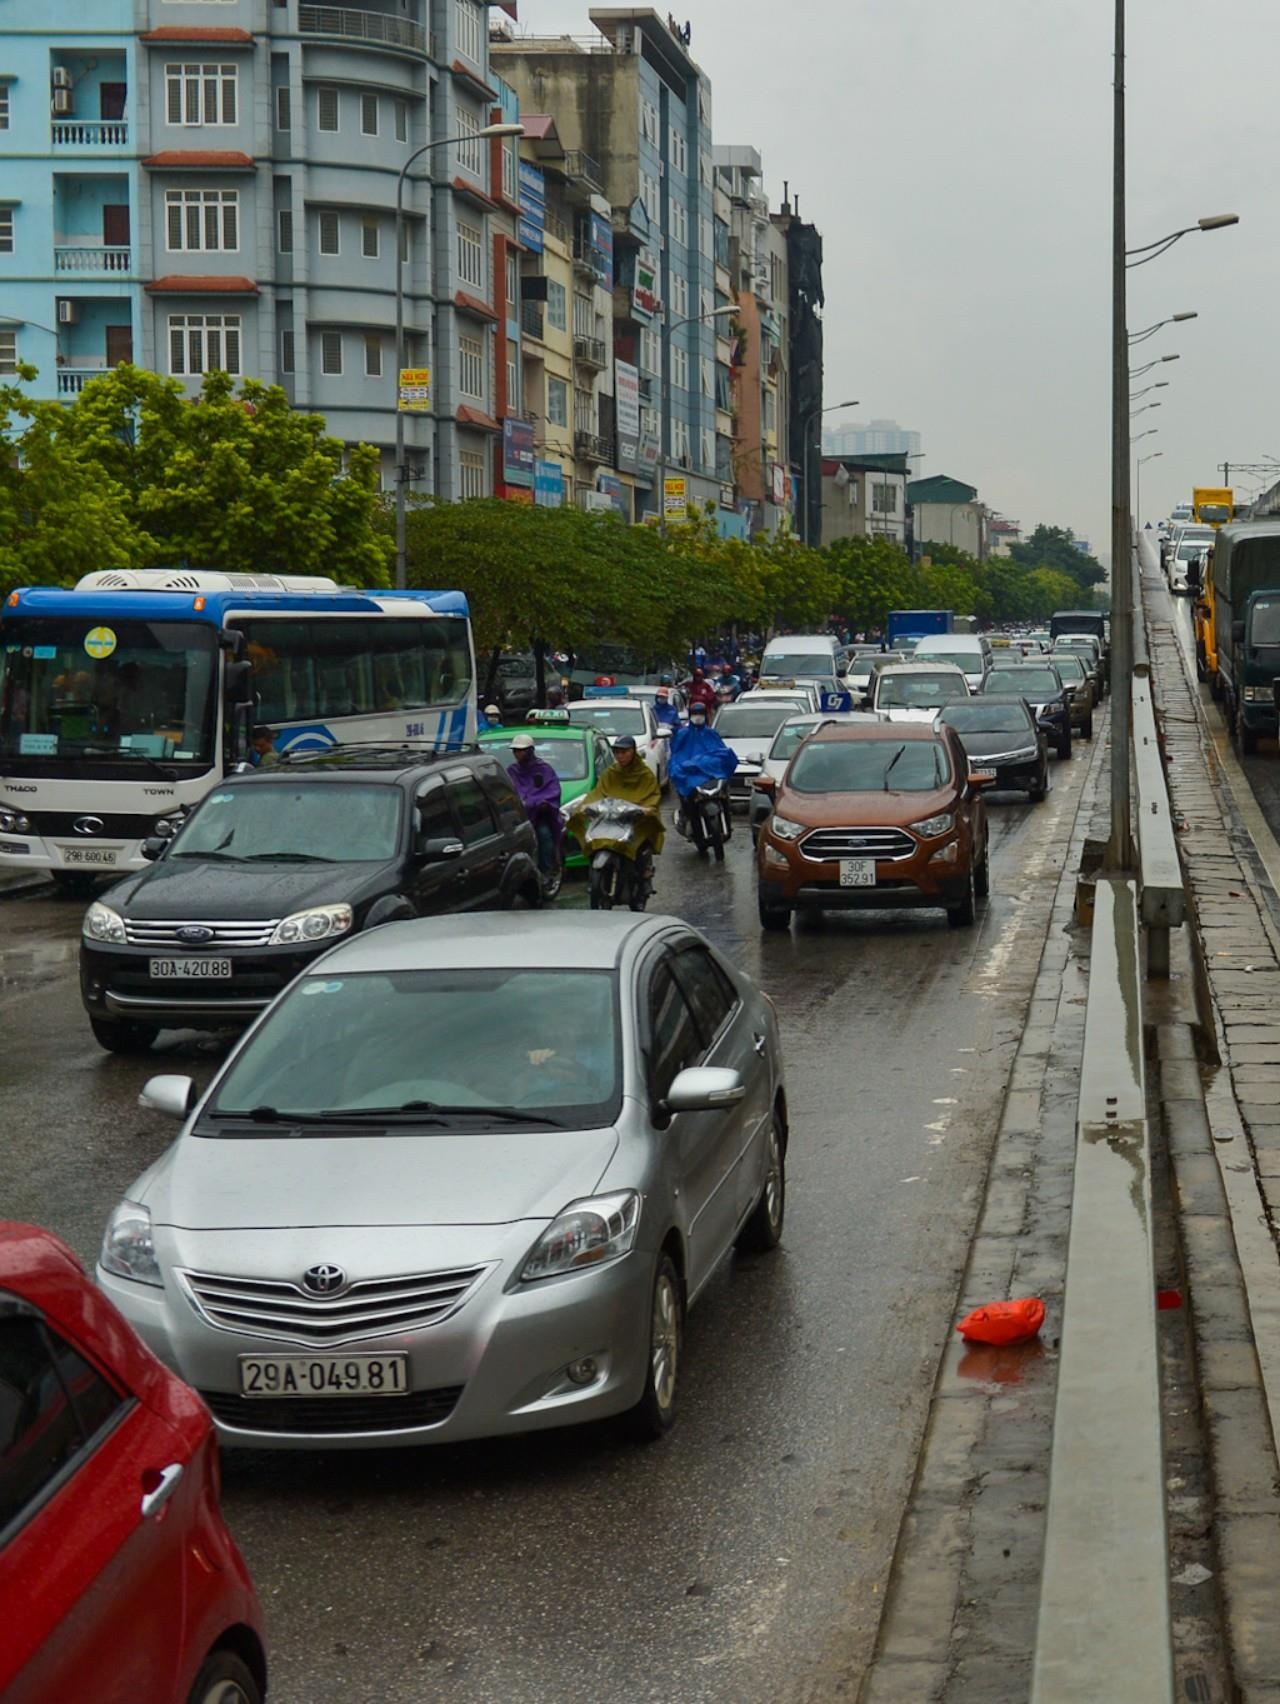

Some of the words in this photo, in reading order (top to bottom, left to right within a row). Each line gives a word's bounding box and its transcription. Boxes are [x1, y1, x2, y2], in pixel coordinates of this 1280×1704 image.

[143, 788, 175, 796] TOWN
[848, 860, 867, 872] 30F
[151, 960, 230, 976] 30A-420.88
[247, 1359, 400, 1391] 29A-049.81
